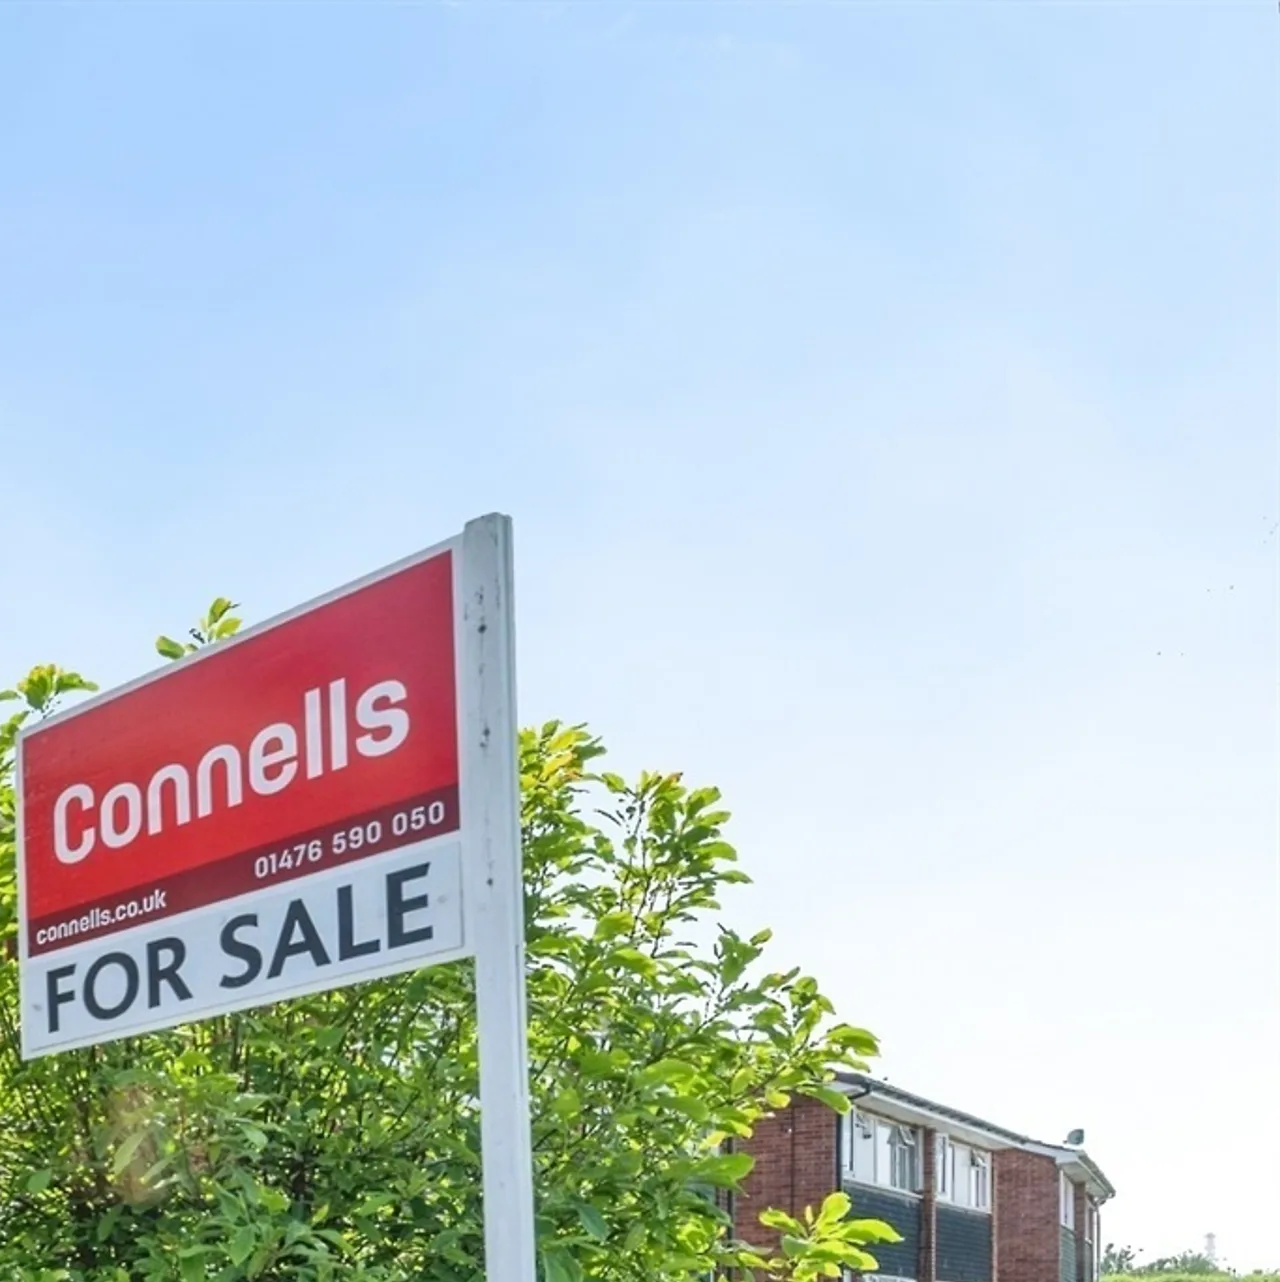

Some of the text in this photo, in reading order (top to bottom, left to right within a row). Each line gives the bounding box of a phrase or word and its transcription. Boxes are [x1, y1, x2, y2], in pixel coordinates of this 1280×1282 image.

[53, 678, 410, 864] Connells
[255, 801, 445, 879] 01476 590 050
[36, 889, 167, 945] connells.co.uk
[46, 861, 433, 1034] FOR SALE
